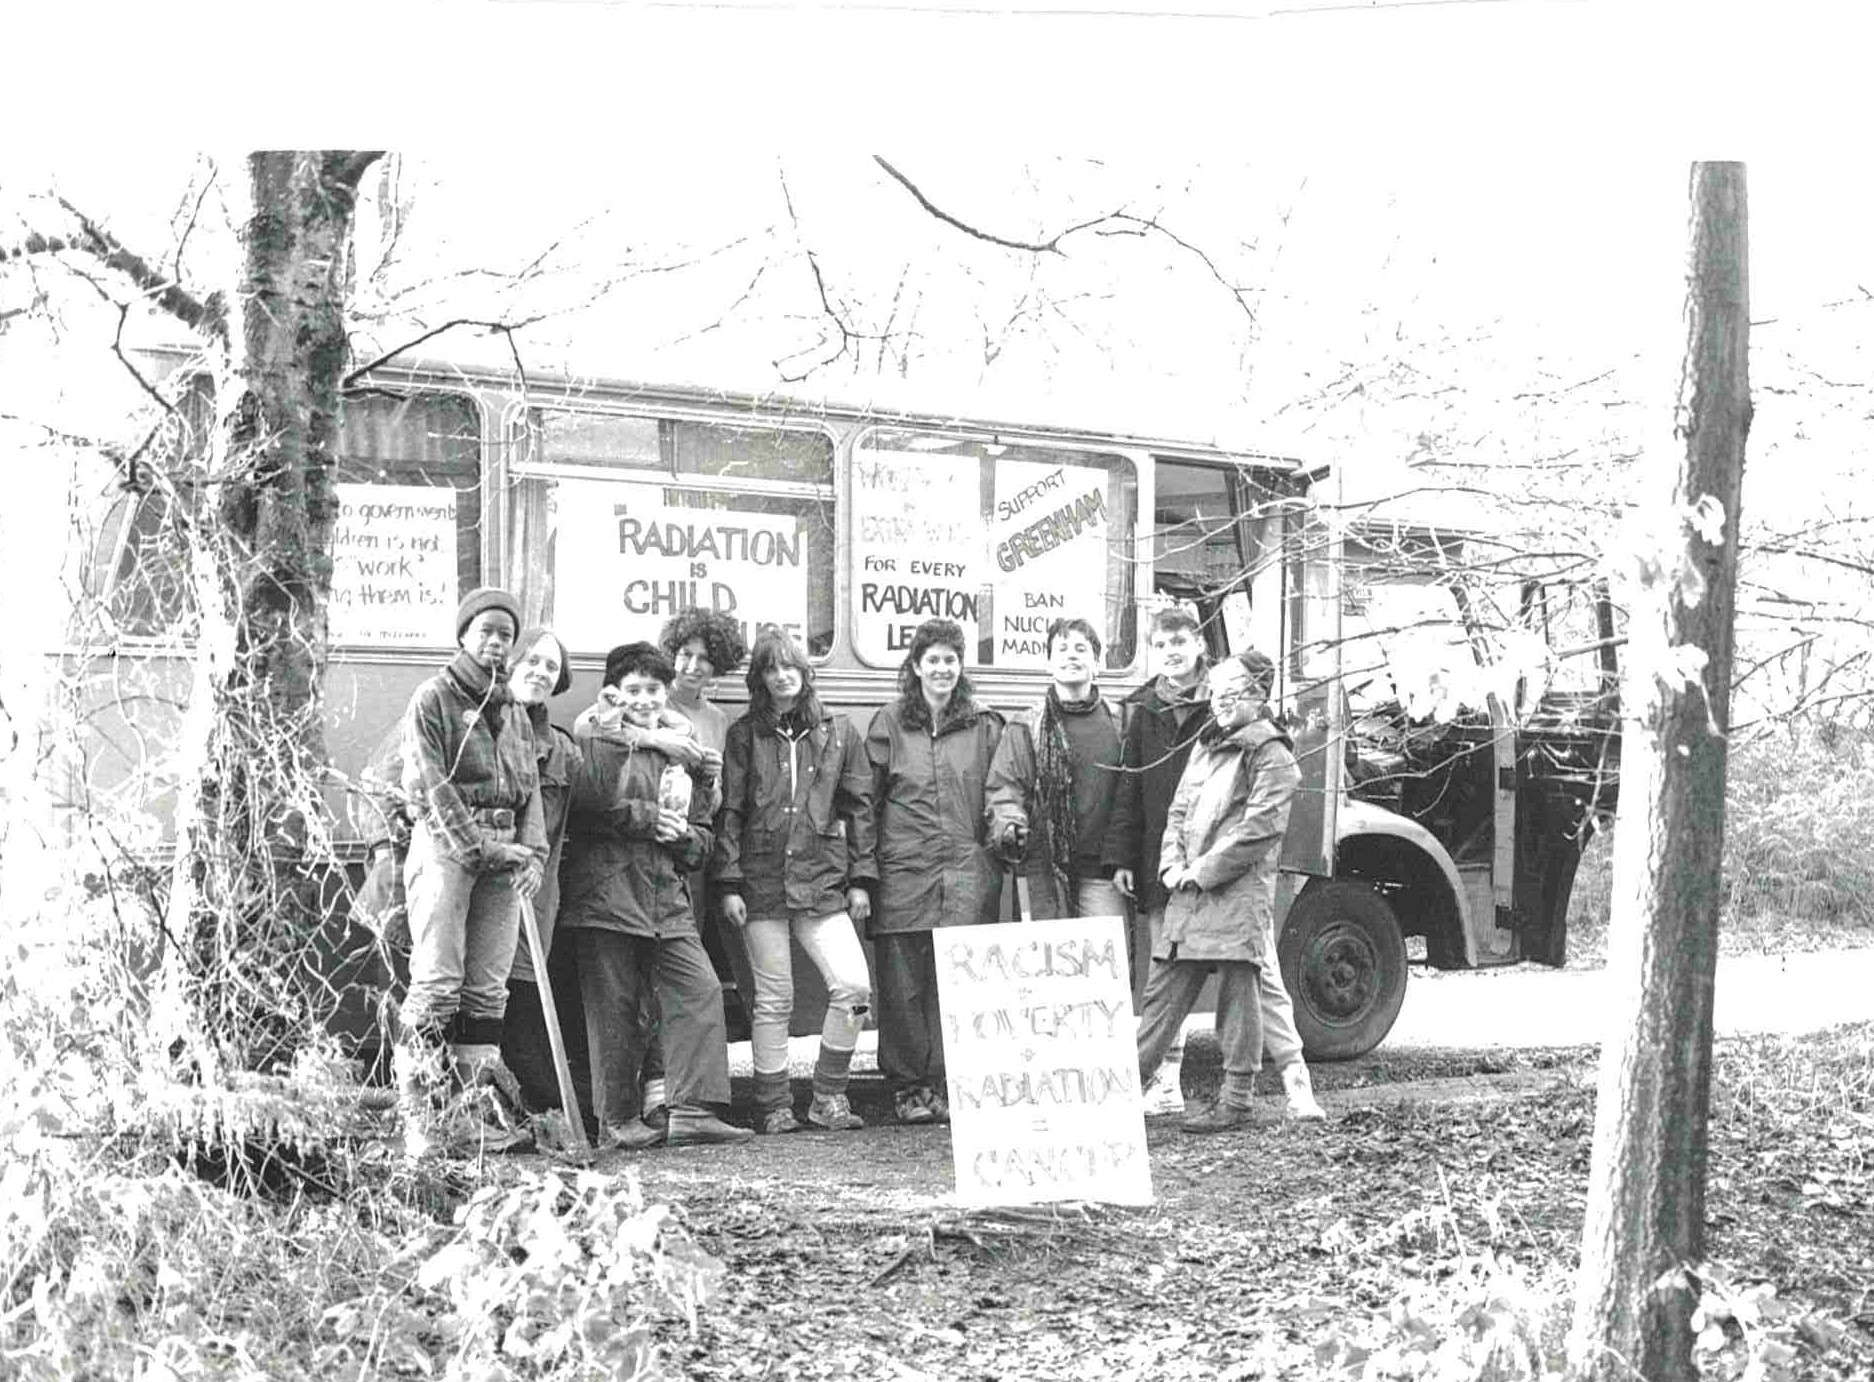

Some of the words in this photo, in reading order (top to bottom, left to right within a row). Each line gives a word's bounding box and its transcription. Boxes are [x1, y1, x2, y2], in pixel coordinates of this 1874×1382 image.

[998, 468, 1067, 521] SUPPORT
[618, 518, 800, 567] RADIATION
[997, 488, 1110, 573] GREENHAM
[690, 562, 708, 579] IS
[864, 555, 897, 572] FOR
[910, 560, 967, 578] EVERY
[623, 580, 738, 616] CHILD
[861, 583, 978, 624] RADIATION
[1024, 592, 1064, 608] BAN
[948, 938, 1119, 984] RACISM
[951, 1066, 1133, 1110] RADIATION
